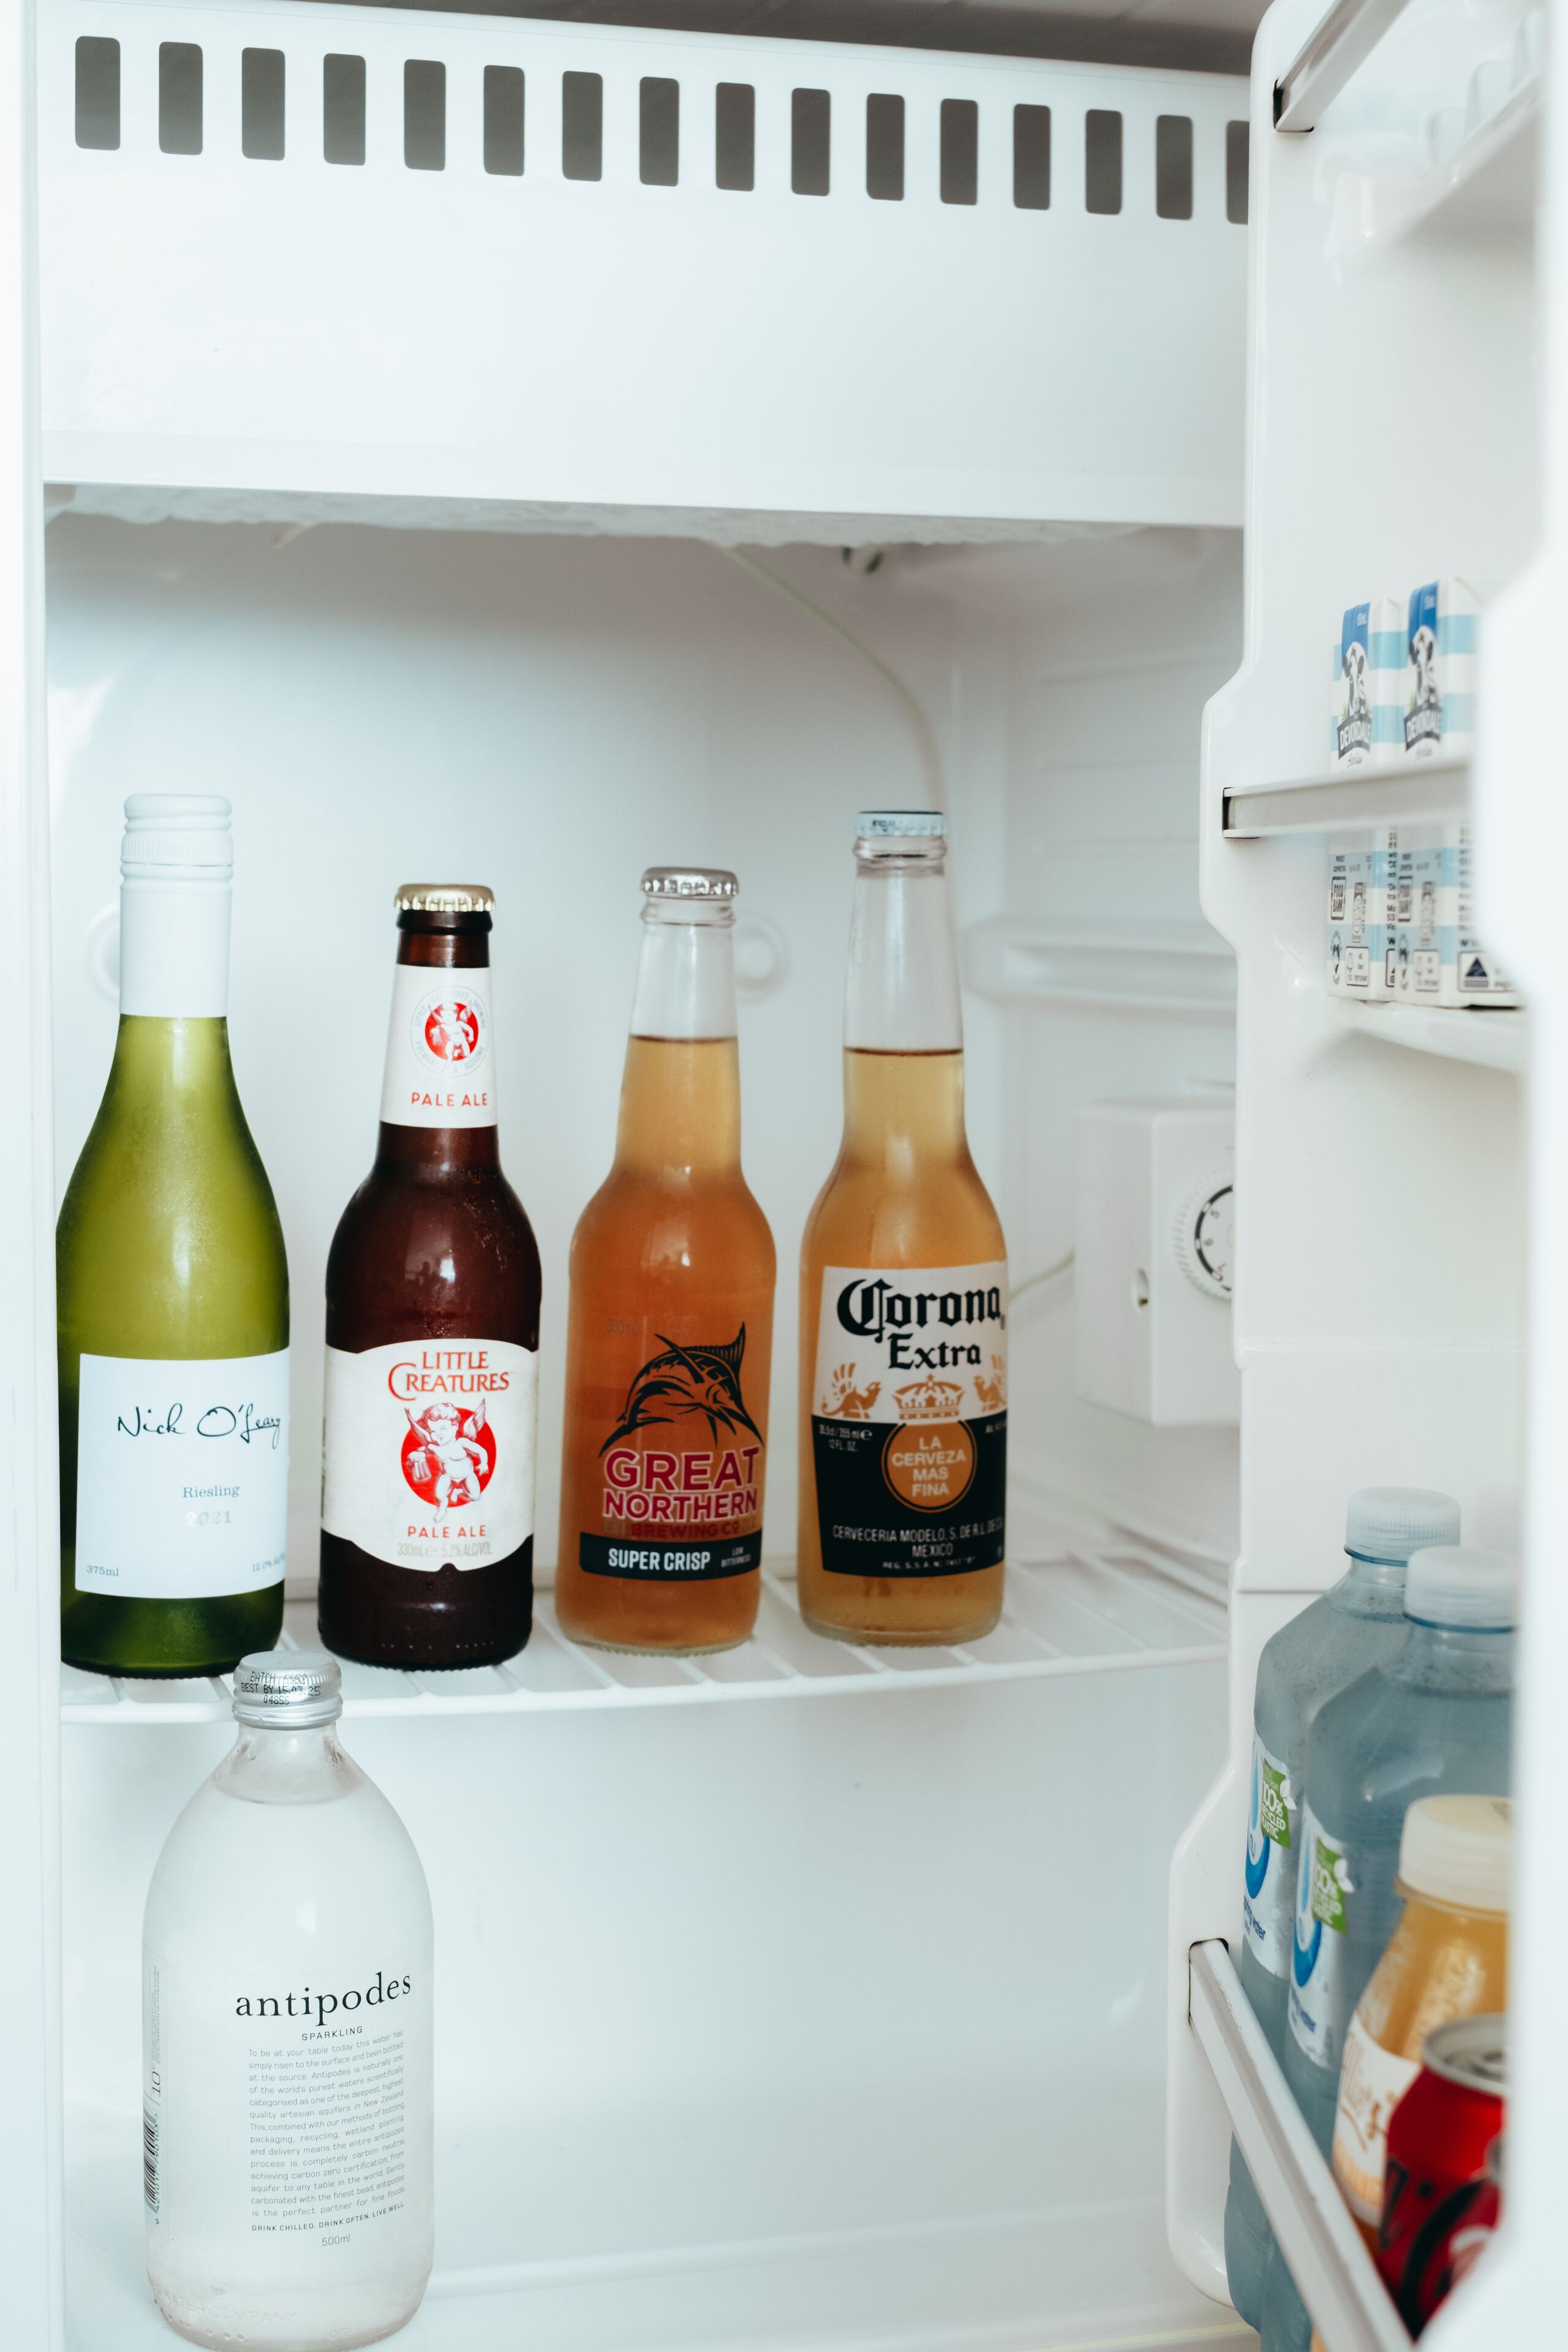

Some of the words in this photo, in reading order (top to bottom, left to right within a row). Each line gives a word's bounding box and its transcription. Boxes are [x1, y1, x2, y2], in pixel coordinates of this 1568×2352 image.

[412, 1092, 454, 1106] PALE
[462, 1091, 488, 1106] ALE
[837, 1278, 1002, 1343] Corona
[422, 1351, 489, 1370] LITTLE
[888, 1333, 982, 1370] Extra
[388, 1362, 510, 1401] CREATURES
[118, 1403, 185, 1437] Nick
[197, 1403, 282, 1450] O'Leary
[919, 1436, 941, 1449] LA
[892, 1447, 967, 1466] CERVEZA
[604, 1446, 760, 1493] GREAT
[913, 1467, 949, 1481] MAS
[183, 1485, 240, 1499] Riesling
[912, 1483, 950, 1496] FINA
[603, 1487, 758, 1523] NORTHERN
[185, 1510, 232, 1527] 2021
[408, 1526, 450, 1538] PALE
[457, 1525, 486, 1537] ALE
[630, 1523, 718, 1539] BREWING
[832, 1525, 897, 1542] CERVECERIA
[608, 1548, 660, 1570] SUPER
[663, 1550, 711, 1571] CRISP
[912, 1542, 953, 1558] MEXICO
[87, 1565, 119, 1577] 375ml
[241, 1682, 259, 1693] BEST
[263, 1684, 274, 1694] BY
[236, 1971, 411, 2027] antipodes
[249, 2049, 258, 2057] To
[308, 2046, 329, 2055] table
[332, 2043, 353, 2052] today
[356, 2040, 370, 2048] this
[372, 2034, 391, 2045] water
[393, 2030, 404, 2038] has
[301, 2026, 364, 2042] SPARKLING
[249, 2062, 273, 2071] simply
[322, 2057, 350, 2066] surface
[352, 2051, 365, 2062] and
[366, 2049, 382, 2059] been
[383, 2041, 404, 2054] bottled
[312, 2068, 351, 2079] Antipodes
[363, 2058, 391, 2071] naturally
[393, 2054, 404, 2063] one
[277, 2085, 306, 2094] world's
[309, 2082, 336, 2093] purest
[338, 2078, 364, 2088] waters
[367, 2066, 404, 2082] scientifically
[249, 2098, 298, 2107] categorised
[327, 2094, 336, 2103] of
[382, 2078, 404, 2090] highest
[249, 2111, 277, 2120] quality
[318, 2106, 351, 2116] aquifers
[250, 2122, 268, 2132] This,
[268, 2122, 307, 2131] combined
[341, 2113, 373, 2124] methods
[374, 2108, 382, 2117] of
[251, 2136, 296, 2144] packaging,
[345, 2123, 375, 2136] wetland
[379, 2114, 404, 2129] planting
[268, 2147, 301, 2156] delivery
[349, 2138, 372, 2147] entire
[374, 2127, 405, 2141] antipodes
[251, 2172, 289, 2181] achieving
[292, 2171, 321, 2179] carbon
[390, 2150, 405, 2160] from
[303, 2155, 349, 2166] completely
[352, 2148, 379, 2159] carbon
[251, 2184, 281, 2193] aquifer
[314, 2180, 335, 2190] table
[386, 2163, 405, 2174] Gently
[298, 2195, 317, 2203] with
[333, 2189, 355, 2199] finest
[376, 2174, 405, 2189] antipodes
[282, 2207, 317, 2217] perfect
[320, 2203, 353, 2214] partner
[372, 2195, 385, 2203] fine
[252, 2224, 277, 2233] DRINK
[318, 2218, 344, 2230] DRINK
[372, 2207, 387, 2217] LIVE
[322, 2233, 351, 2247] 500ml
